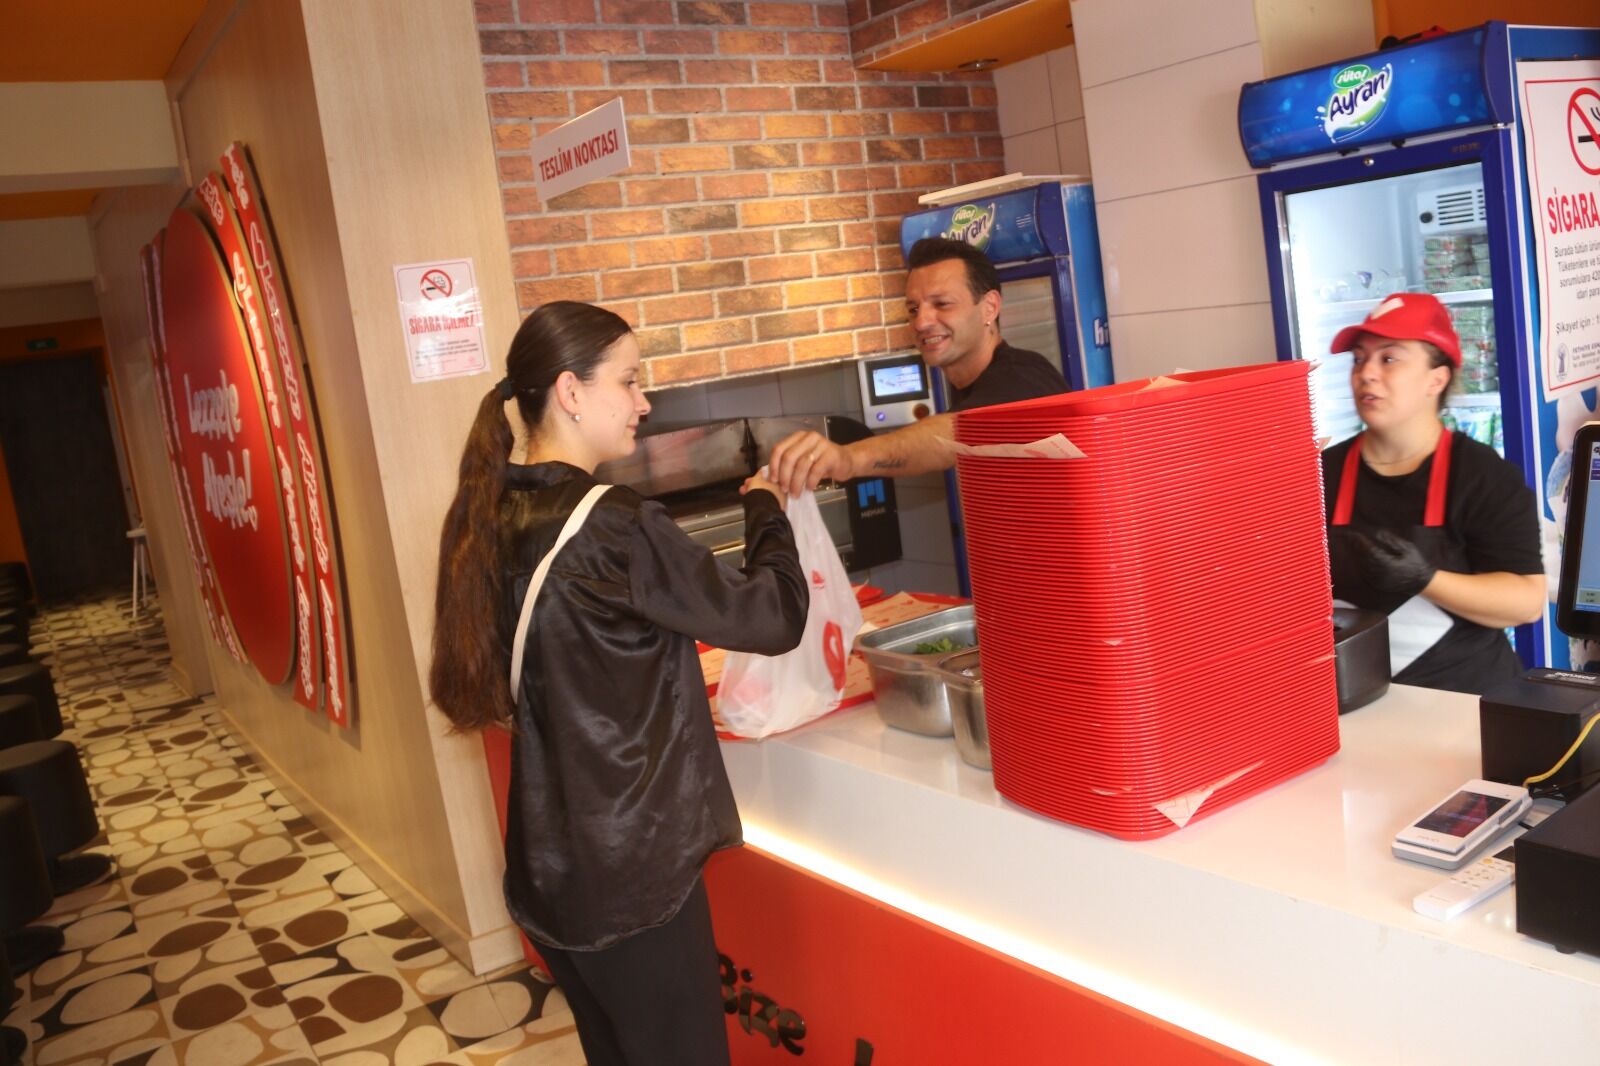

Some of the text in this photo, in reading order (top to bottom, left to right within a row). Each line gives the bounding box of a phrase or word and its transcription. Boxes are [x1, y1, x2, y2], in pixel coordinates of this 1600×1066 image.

[1330, 73, 1385, 122] Ayran
[539, 129, 619, 181] TESLİM NOKTASI
[1547, 187, 1600, 234] SİGARA
